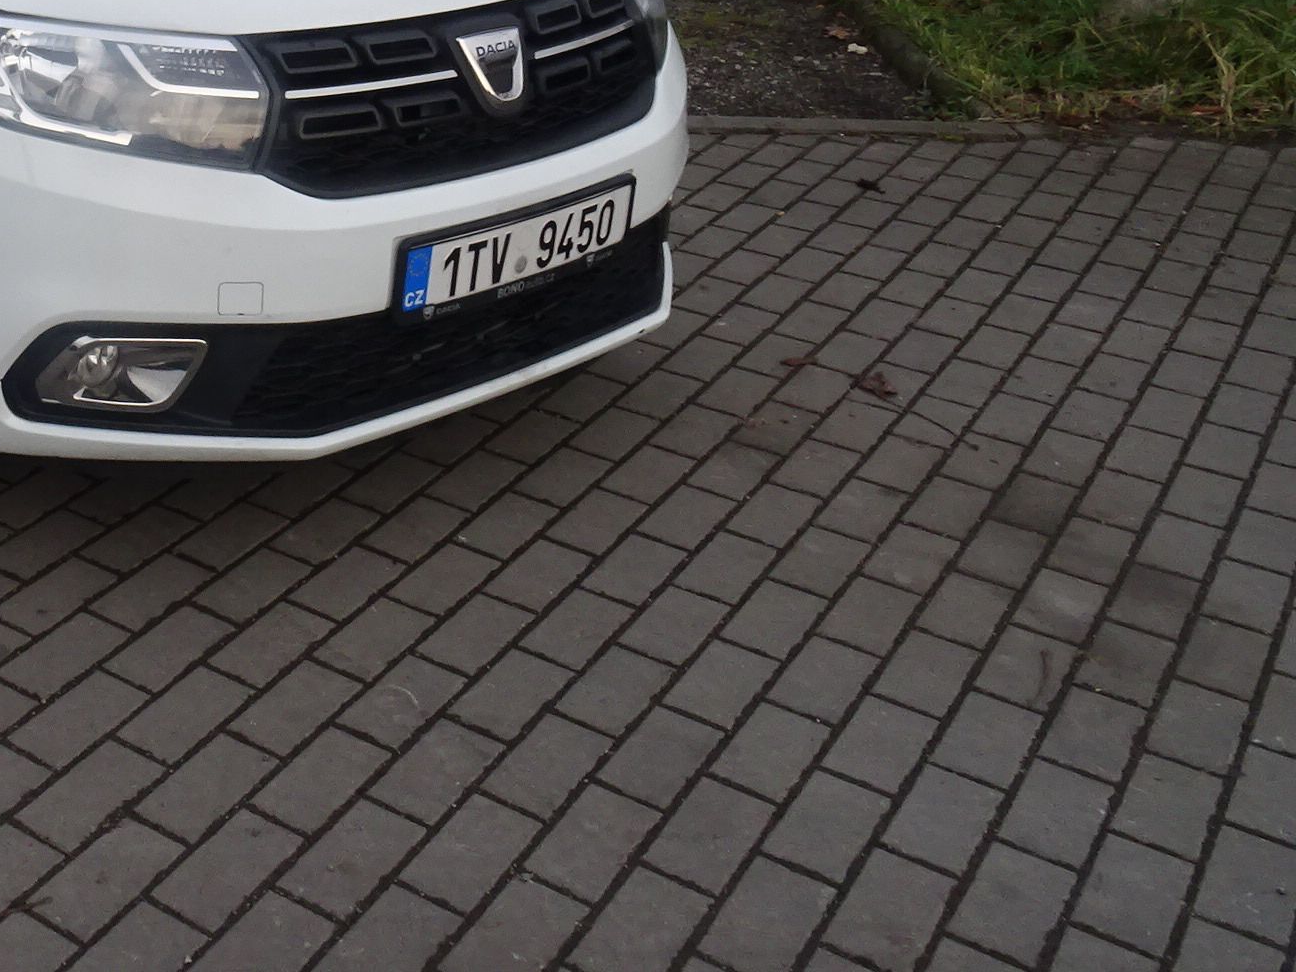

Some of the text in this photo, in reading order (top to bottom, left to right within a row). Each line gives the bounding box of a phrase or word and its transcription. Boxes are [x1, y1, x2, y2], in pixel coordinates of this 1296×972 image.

[475, 40, 516, 57] DACIA
[443, 199, 615, 297] 1TV 9450
[404, 289, 425, 308] CZ
